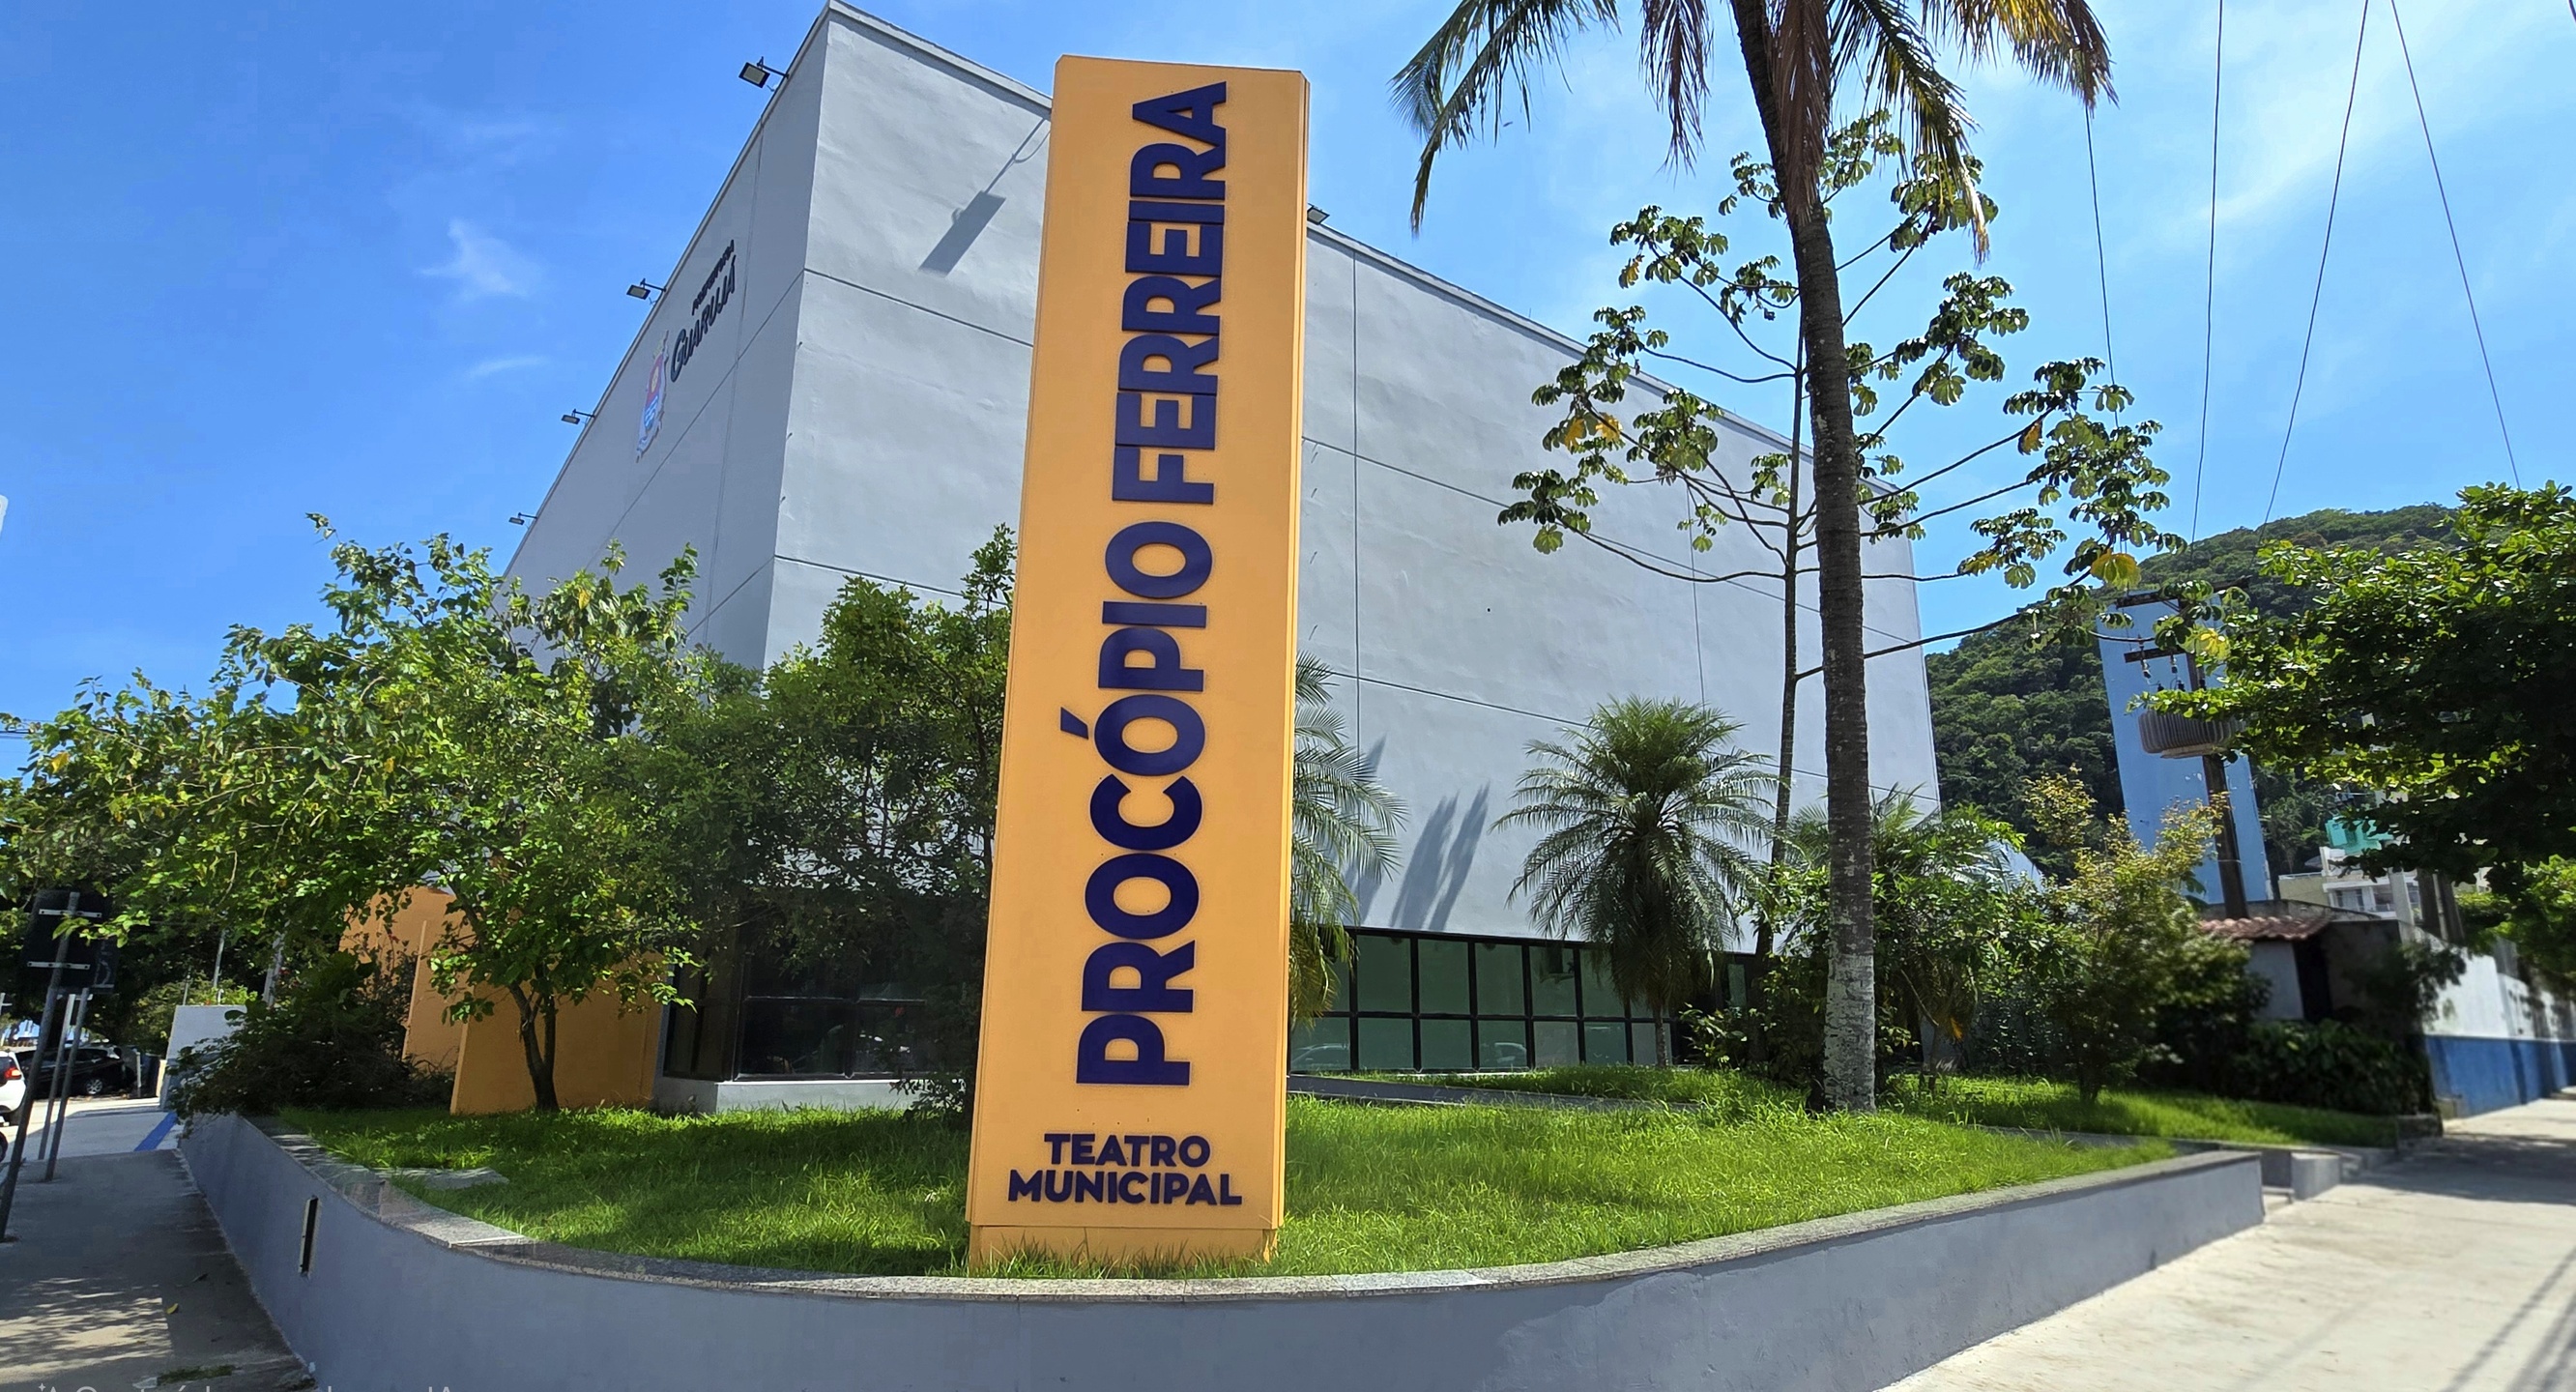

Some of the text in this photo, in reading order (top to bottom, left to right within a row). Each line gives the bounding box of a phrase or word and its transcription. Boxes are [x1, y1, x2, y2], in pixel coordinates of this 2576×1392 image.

[1060, 80, 1227, 1086] PROCÓPIO FERREIRA
[1044, 1132, 1212, 1167] TEATRO
[1007, 1169, 1243, 1205] MUNICIPAL
